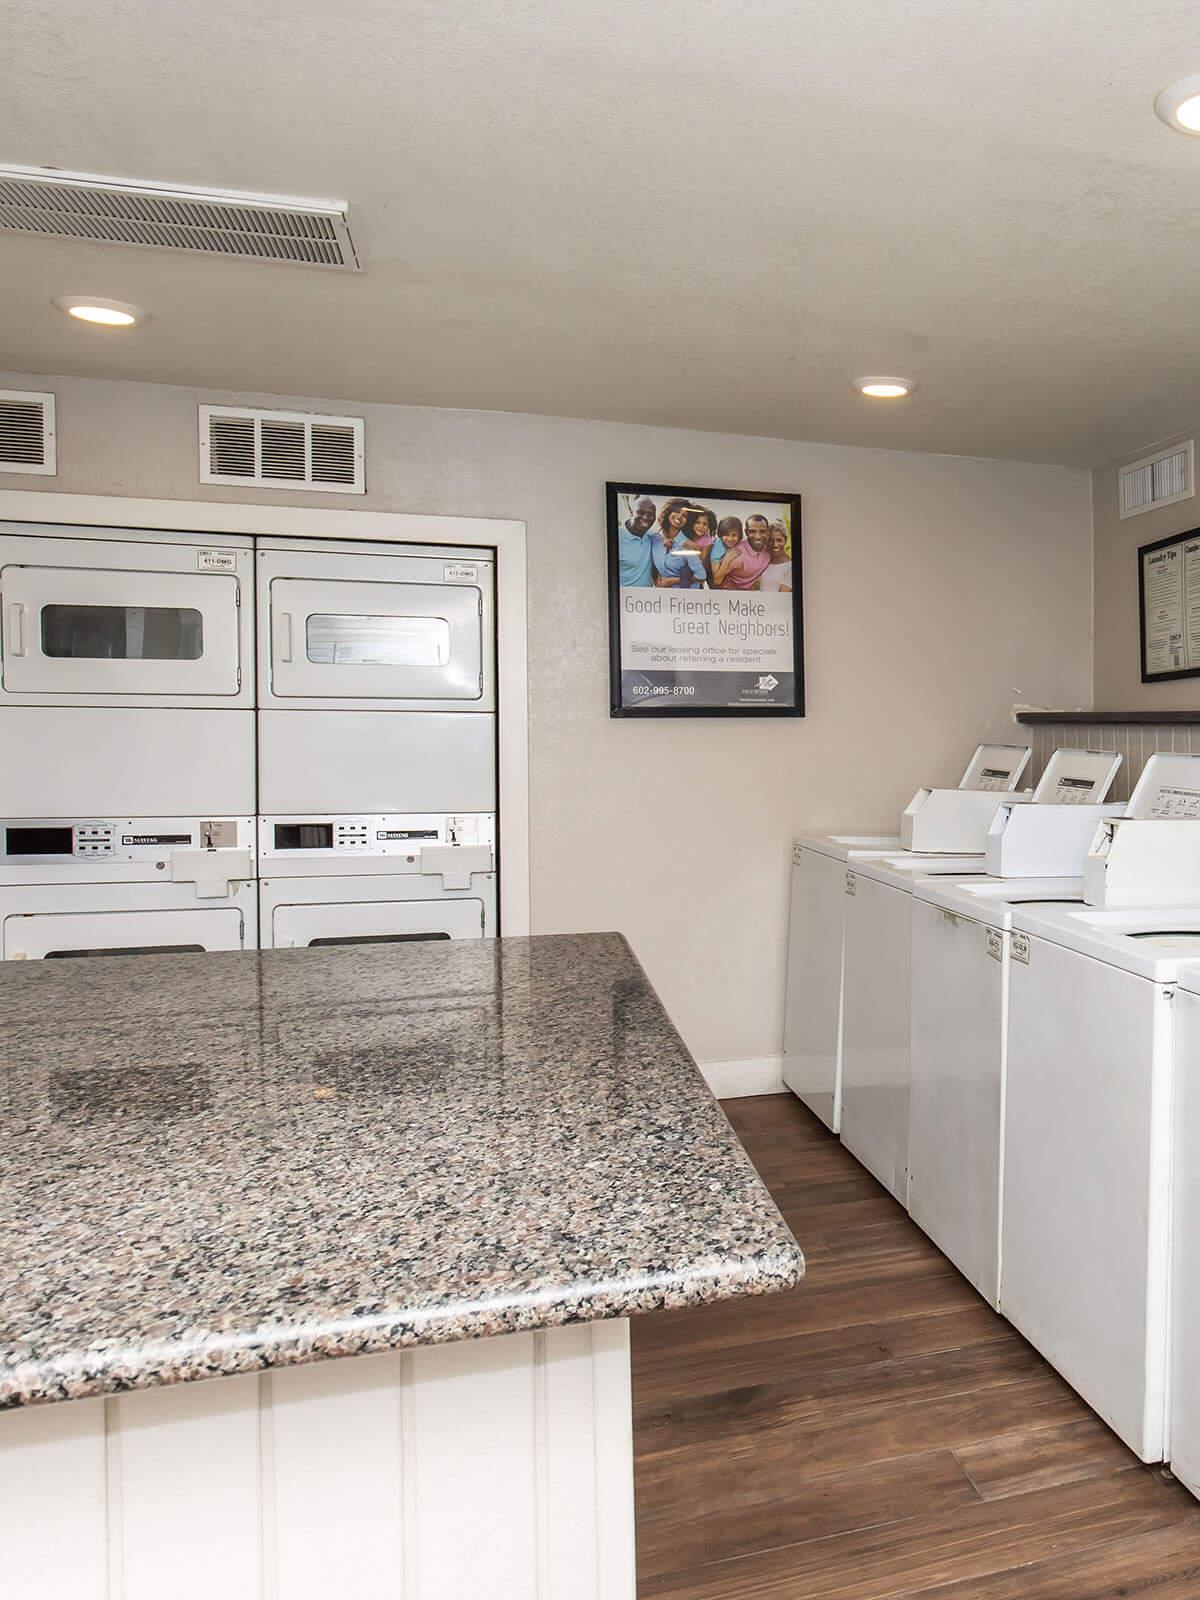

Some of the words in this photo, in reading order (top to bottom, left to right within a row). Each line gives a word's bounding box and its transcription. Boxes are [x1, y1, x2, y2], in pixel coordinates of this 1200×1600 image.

[1167, 551, 1177, 560] Tips
[625, 596, 662, 614] Good
[670, 598, 720, 616] Friends
[729, 600, 766, 617] Make
[673, 618, 711, 636] Great
[719, 619, 790, 641] Neighbors!
[631, 645, 649, 654] See
[651, 646, 666, 654] our
[669, 646, 699, 655] leasing
[702, 646, 726, 655] office
[729, 647, 740, 655] for
[743, 647, 777, 657] specials
[650, 654, 677, 662] about
[680, 654, 716, 664] referring
[726, 656, 761, 664] resident
[632, 686, 695, 696] 602-995-8700
